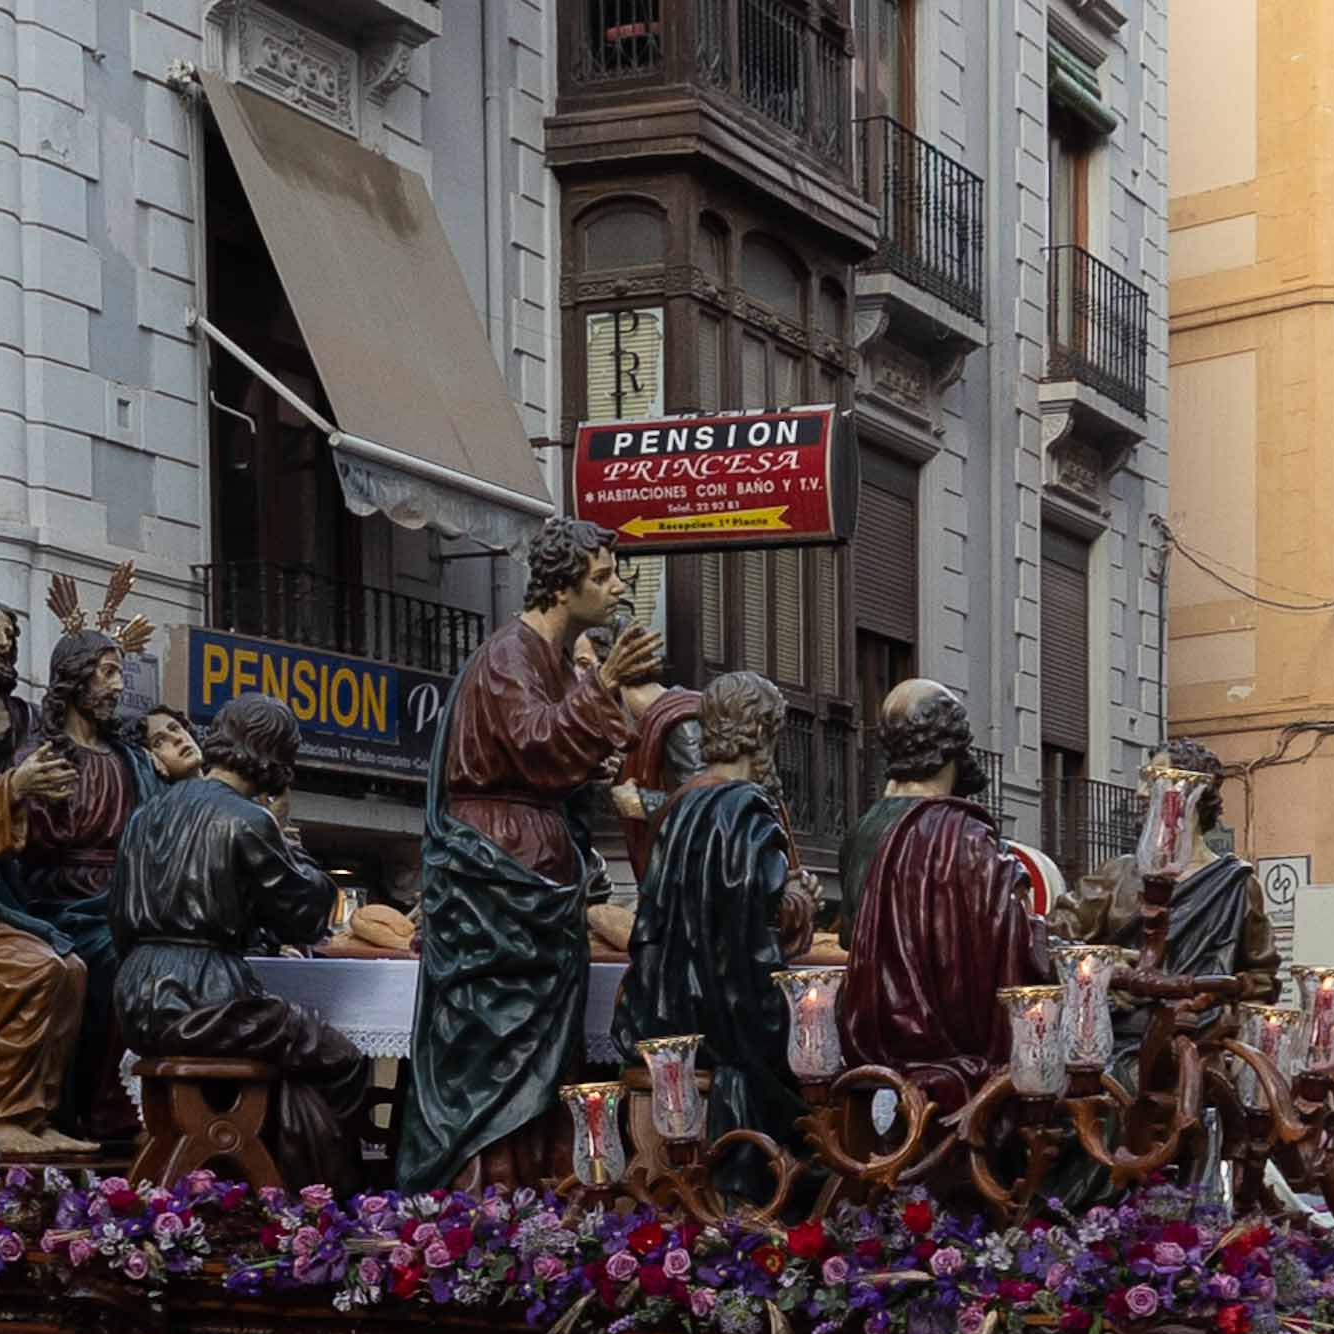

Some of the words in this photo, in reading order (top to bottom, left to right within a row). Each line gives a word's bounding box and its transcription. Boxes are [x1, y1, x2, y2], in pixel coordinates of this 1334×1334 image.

[613, 420, 799, 456] PENSION
[603, 450, 801, 482] PRINCESA
[696, 482, 727, 498] CON
[737, 477, 775, 495] BAÑO
[782, 479, 791, 492] Y
[202, 643, 388, 733] PENSION
